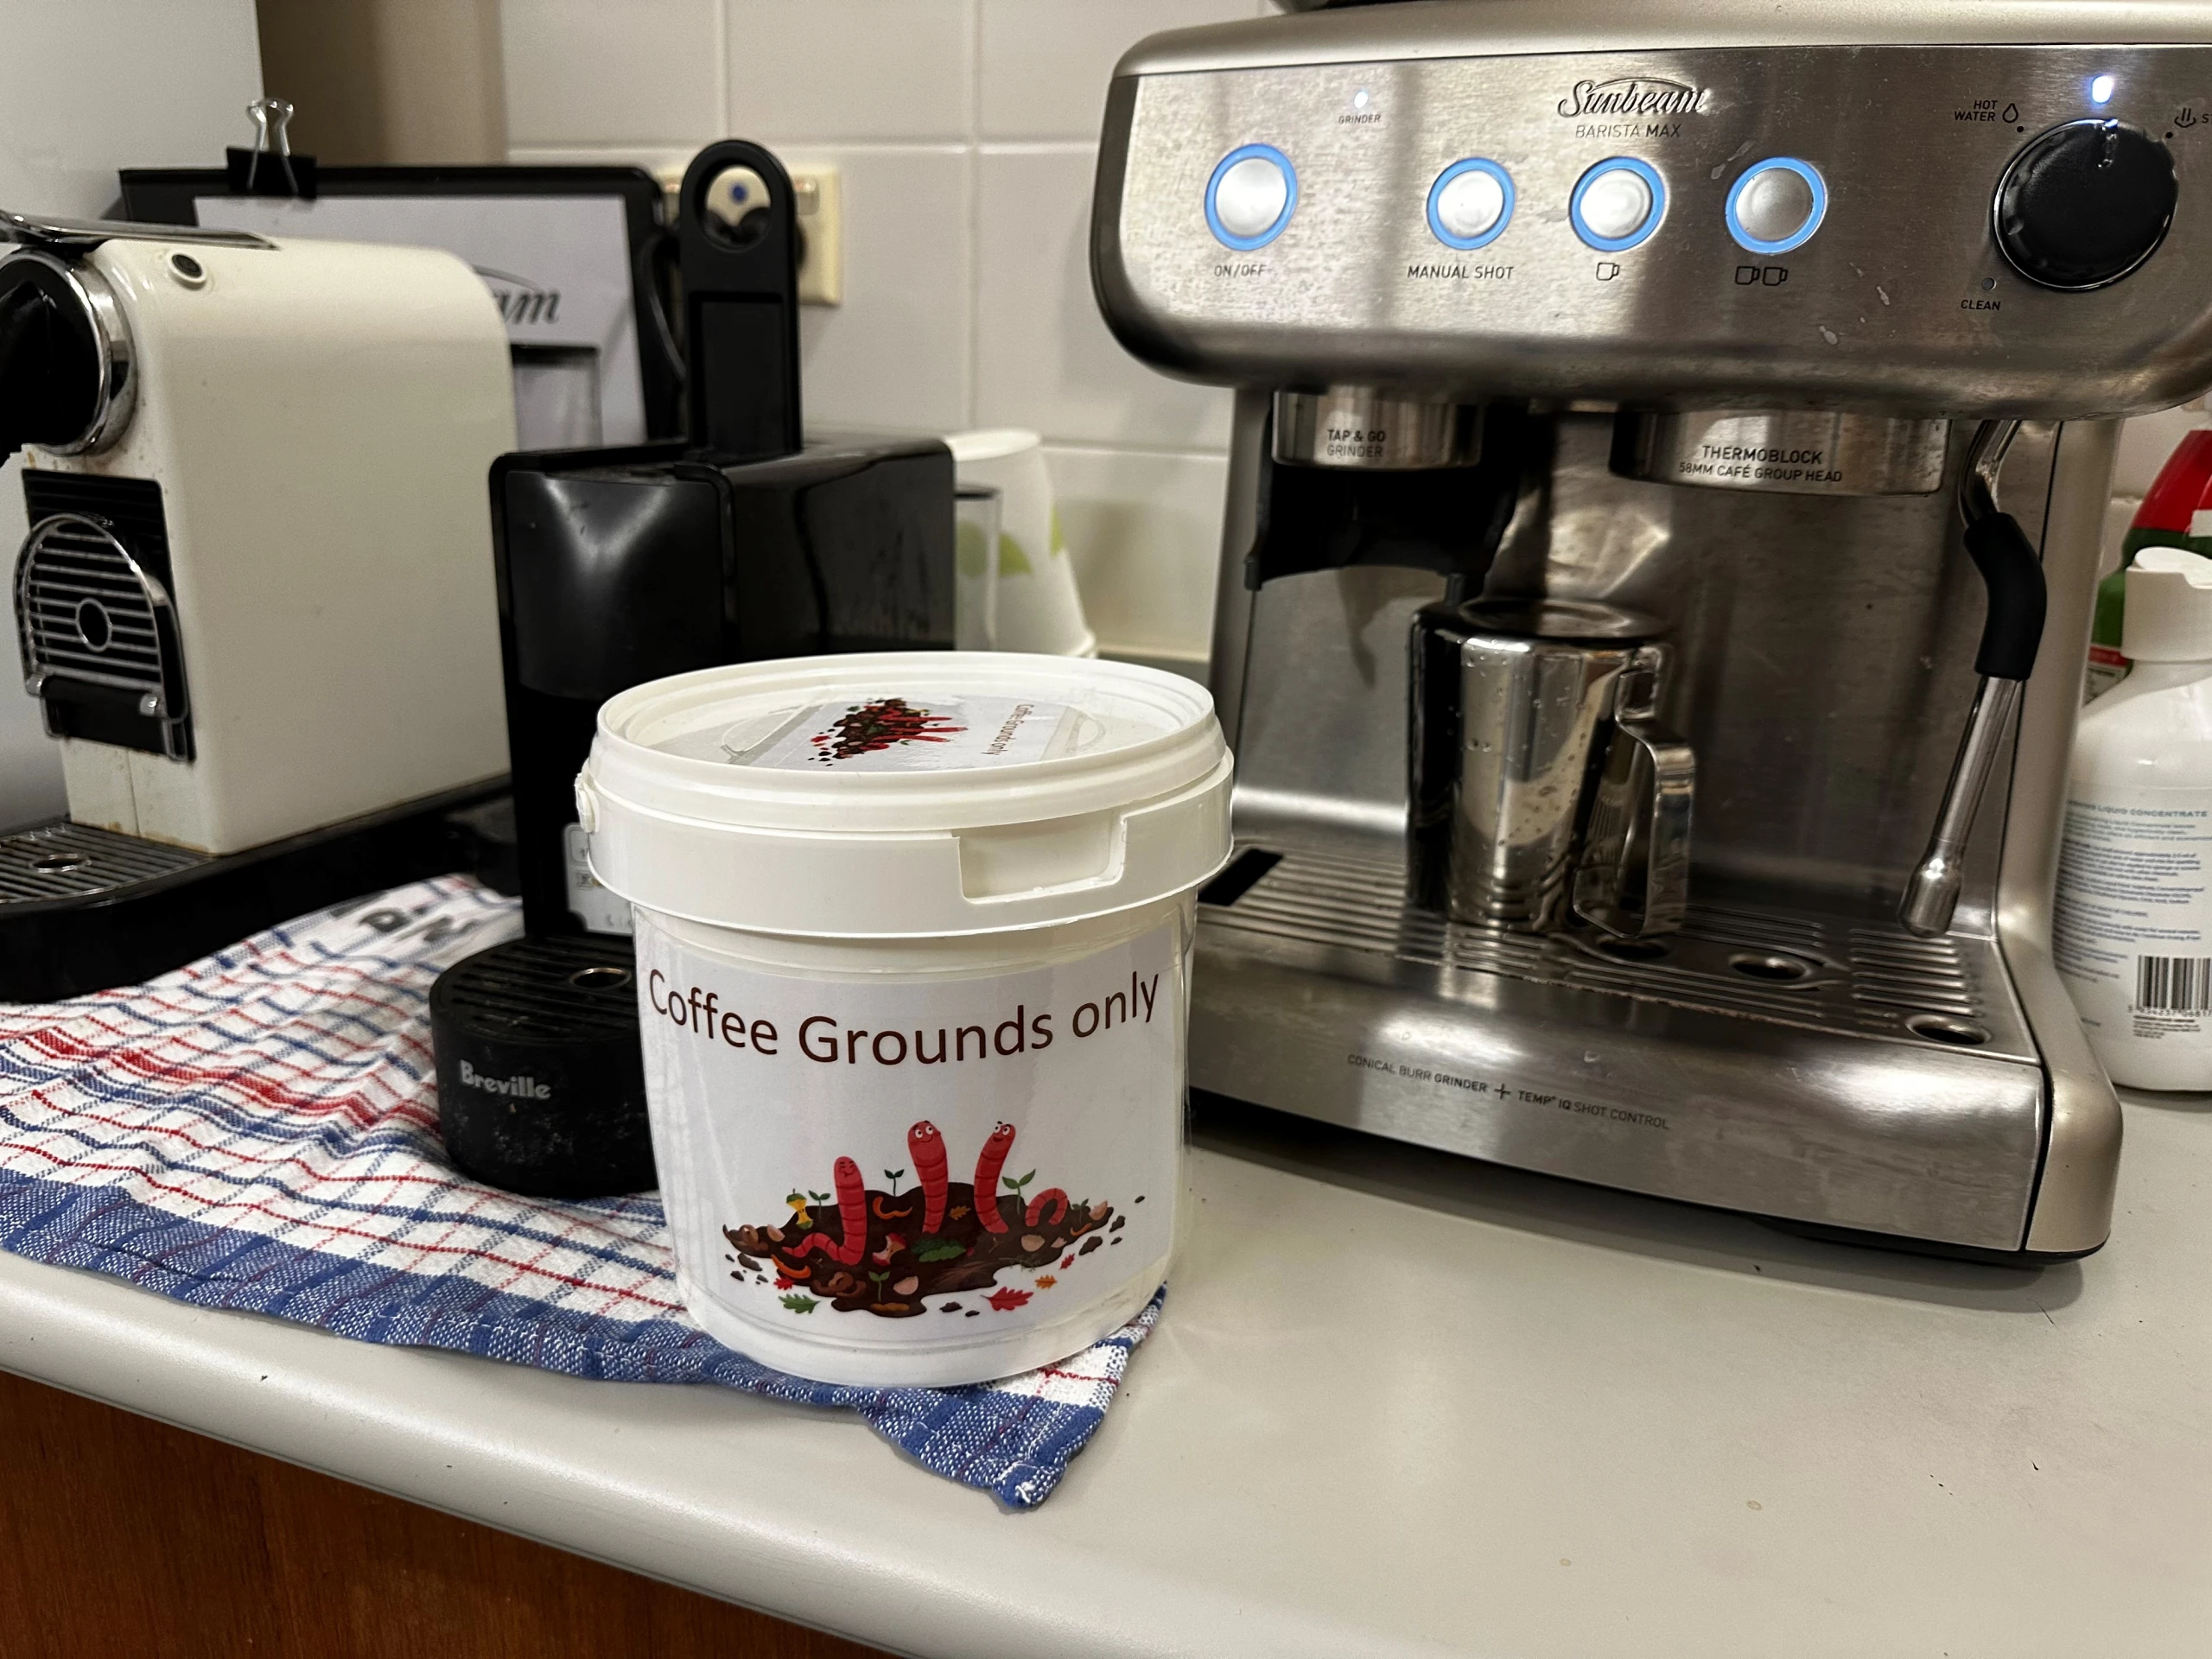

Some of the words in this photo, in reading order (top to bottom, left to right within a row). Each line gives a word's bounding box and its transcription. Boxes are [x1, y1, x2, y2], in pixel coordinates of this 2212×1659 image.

[1558, 77, 1712, 118] Sunbeam
[1974, 99, 1998, 110] HOT
[1338, 113, 1382, 124] GRINDER
[1954, 111, 1996, 122] WATER
[1575, 124, 1641, 138] BARISTA
[1644, 124, 1681, 138] MAX
[1214, 264, 1268, 277] ON/OFF
[1407, 266, 1469, 279] MANUAL
[1474, 266, 1514, 280] SHOT
[1961, 299, 2001, 311] CLEAN
[1327, 429, 1351, 442] TAP
[1353, 430, 1363, 443] &
[1368, 430, 1386, 443] GO
[1326, 445, 1382, 458] GRINDER
[1702, 445, 1823, 465] THERMOBLOCK
[1679, 461, 1713, 475] 58MM
[1717, 465, 1750, 479] CAFÉ
[1754, 468, 1802, 480] GROUP
[1805, 470, 1843, 482] HEAD
[649, 969, 779, 1055] Coffee
[798, 1005, 1053, 1066] Grounds
[1071, 971, 1160, 1038] only
[459, 1058, 550, 1100] Breville
[1347, 1053, 1395, 1074] CONICAL
[1399, 1065, 1431, 1080] BURR
[1433, 1072, 1488, 1092] GRINDER
[1558, 1098, 1571, 1110] IQ
[1573, 1101, 1607, 1116] SHOT
[1610, 1109, 1672, 1131] CONTROL
